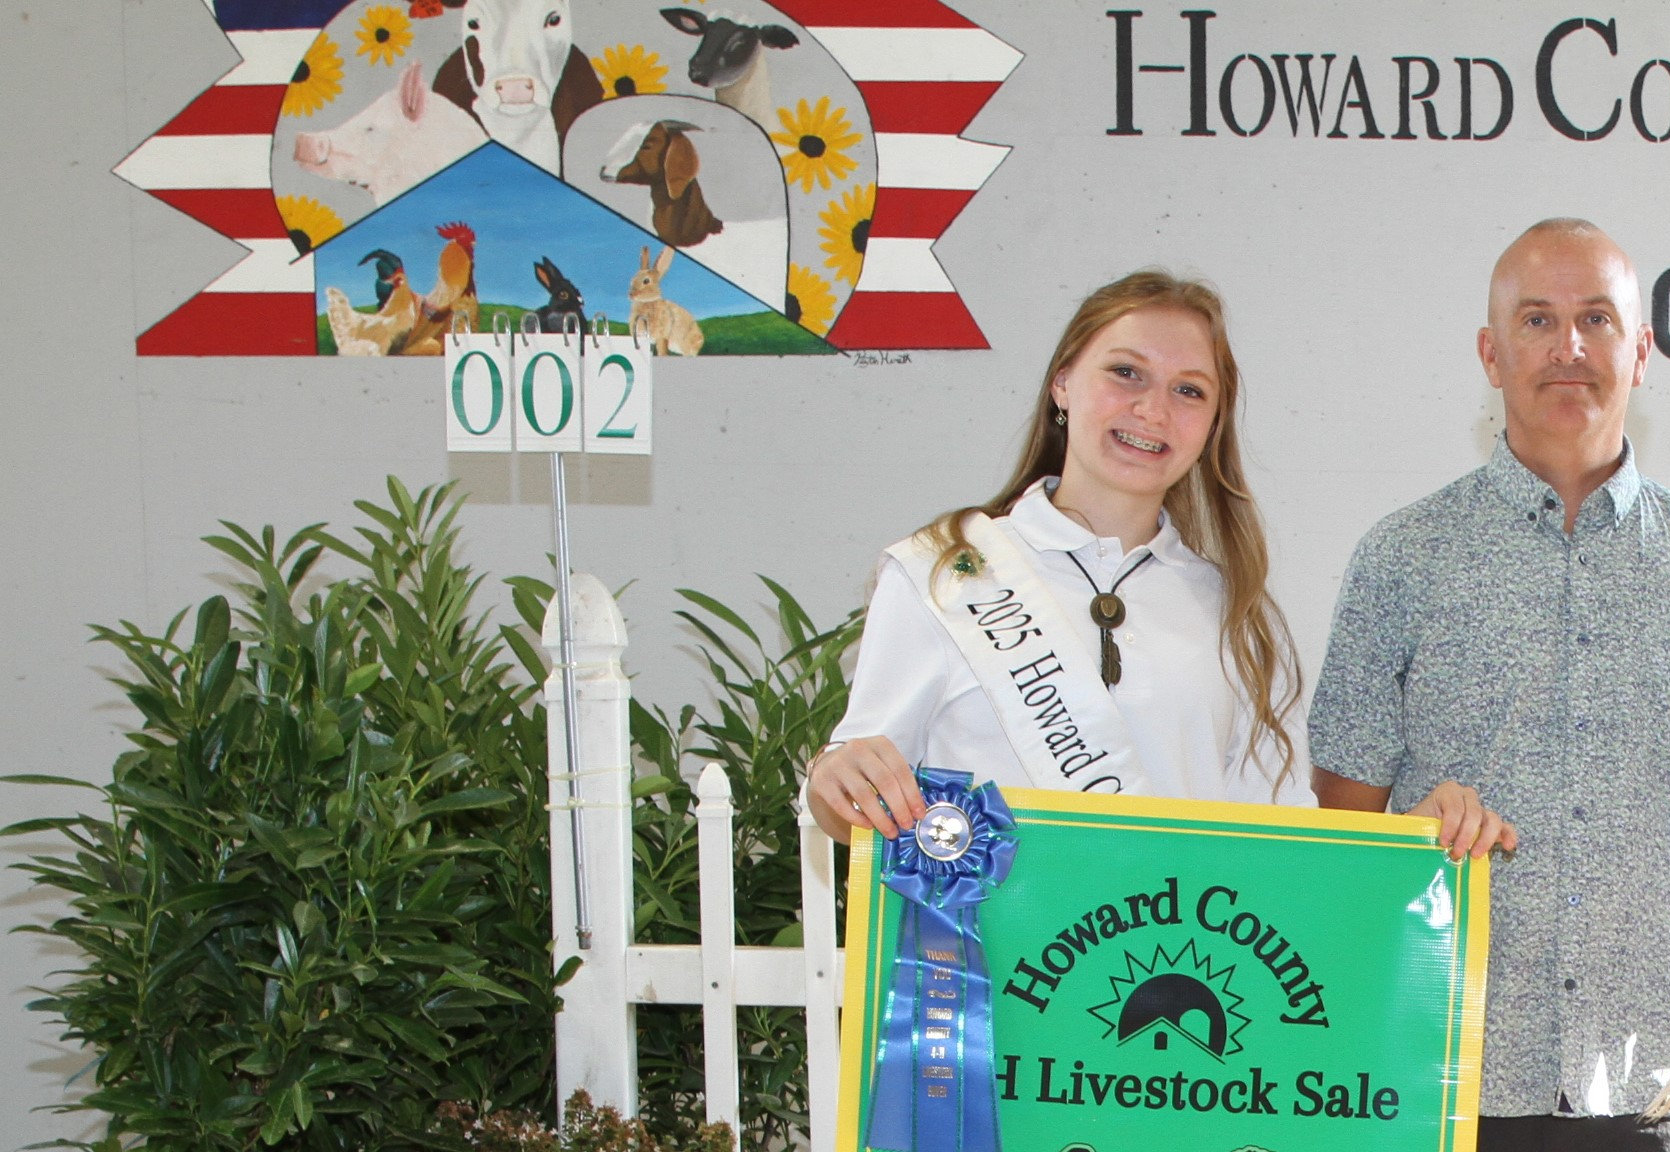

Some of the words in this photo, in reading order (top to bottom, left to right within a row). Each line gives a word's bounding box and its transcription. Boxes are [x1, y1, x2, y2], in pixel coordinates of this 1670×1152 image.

[967, 589, 1042, 652] 2025
[1009, 650, 1109, 780] Howard
[925, 950, 957, 962] THANK
[1002, 876, 1183, 1014] Howard
[1195, 885, 1330, 1029] County
[1036, 1057, 1279, 1116] Livestock
[1293, 1071, 1400, 1121] Sale
